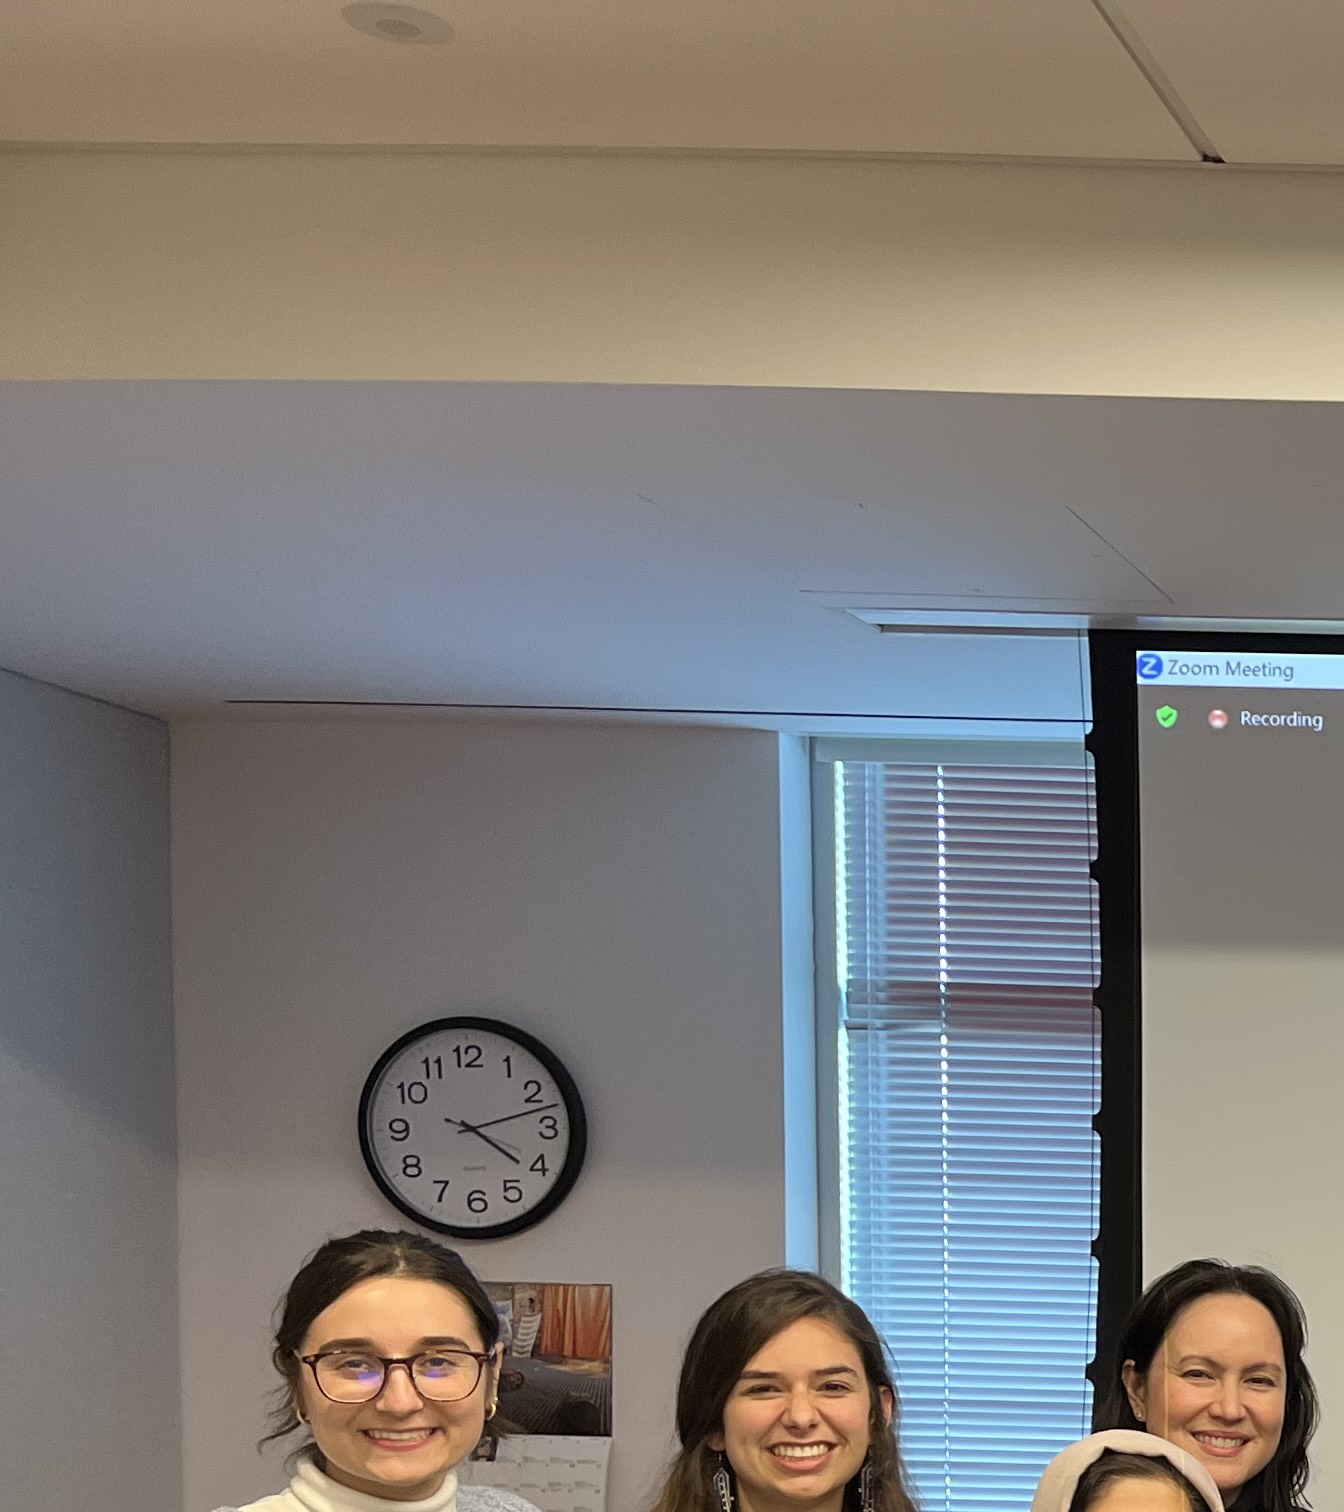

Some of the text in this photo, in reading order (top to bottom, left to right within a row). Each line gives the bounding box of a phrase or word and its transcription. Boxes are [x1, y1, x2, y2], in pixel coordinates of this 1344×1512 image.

[1168, 659, 1219, 676] Zoom
[1226, 661, 1294, 682] Meeting
[1241, 710, 1324, 731] Recording
[421, 1055, 443, 1079] 11
[452, 1044, 484, 1069] 12
[503, 1055, 512, 1078] 1
[396, 1081, 428, 1104] 10
[523, 1080, 544, 1104] 2
[388, 1117, 410, 1142] 9
[538, 1115, 559, 1140] 3
[401, 1154, 423, 1178] 8
[529, 1153, 550, 1177] 4
[433, 1180, 450, 1203] 7
[466, 1189, 489, 1213] 6
[503, 1179, 523, 1203] 5
